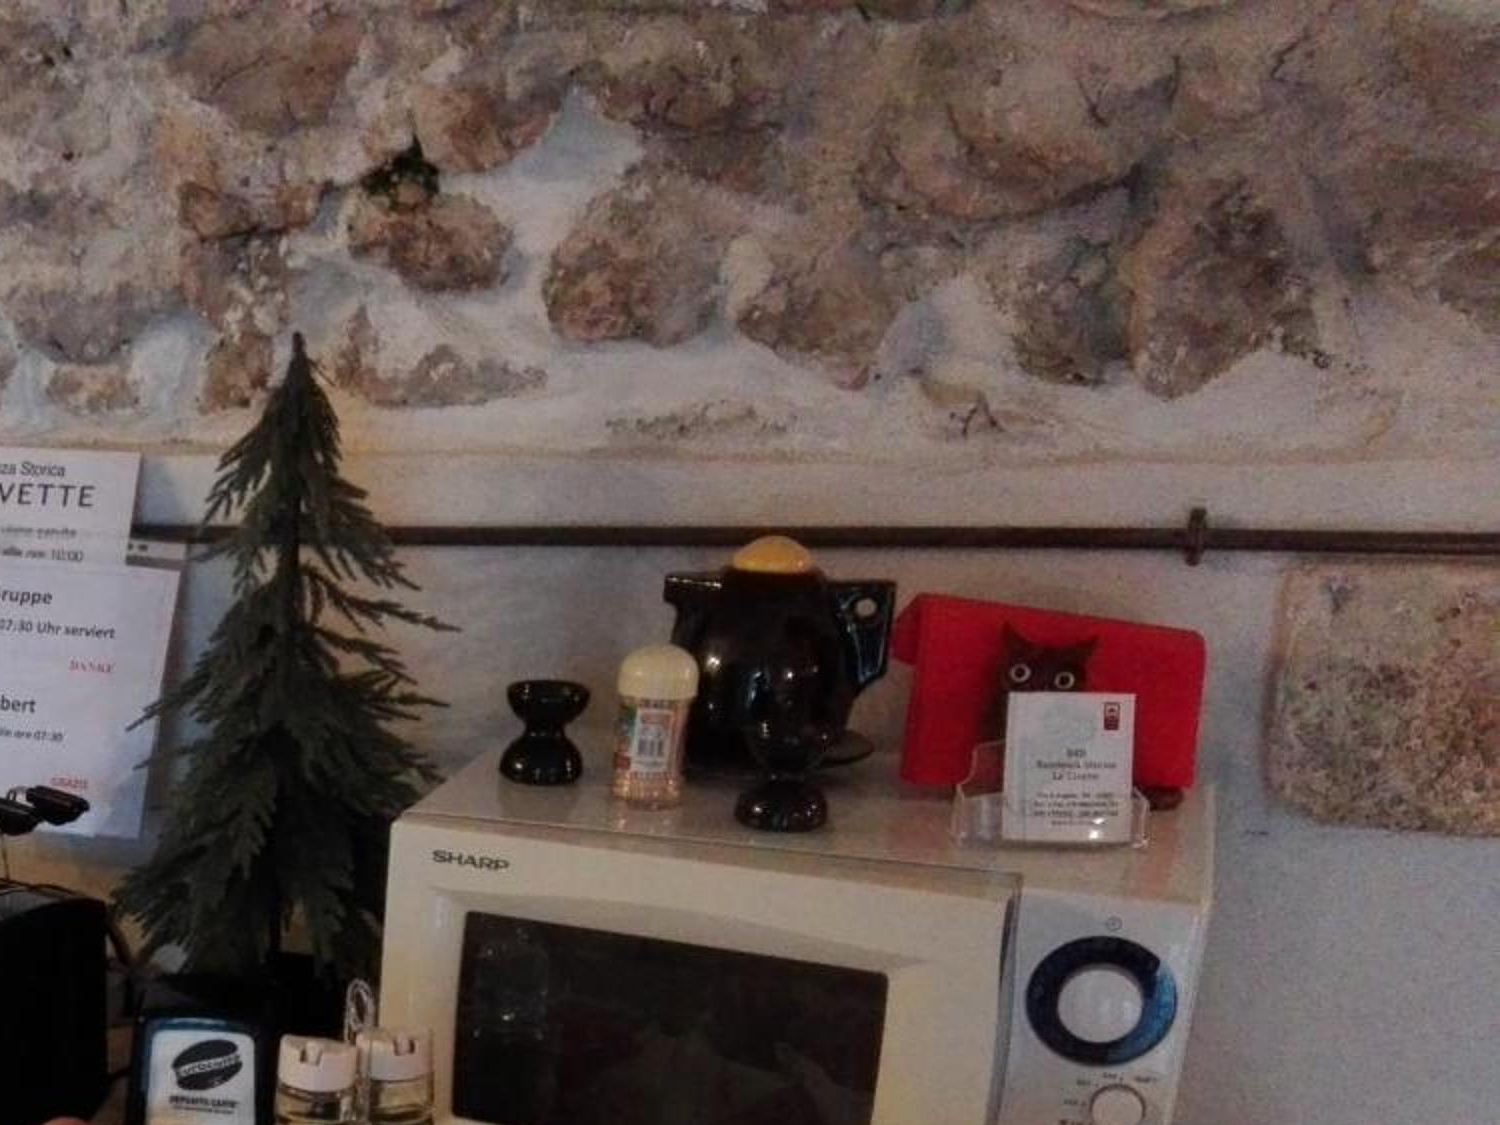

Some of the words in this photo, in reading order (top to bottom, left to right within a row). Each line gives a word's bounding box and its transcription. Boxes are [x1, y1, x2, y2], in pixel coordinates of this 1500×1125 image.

[20, 461, 66, 477] Storica
[37, 621, 61, 637] Uhr
[64, 624, 116, 640] serviert
[432, 849, 511, 871] SHARP
